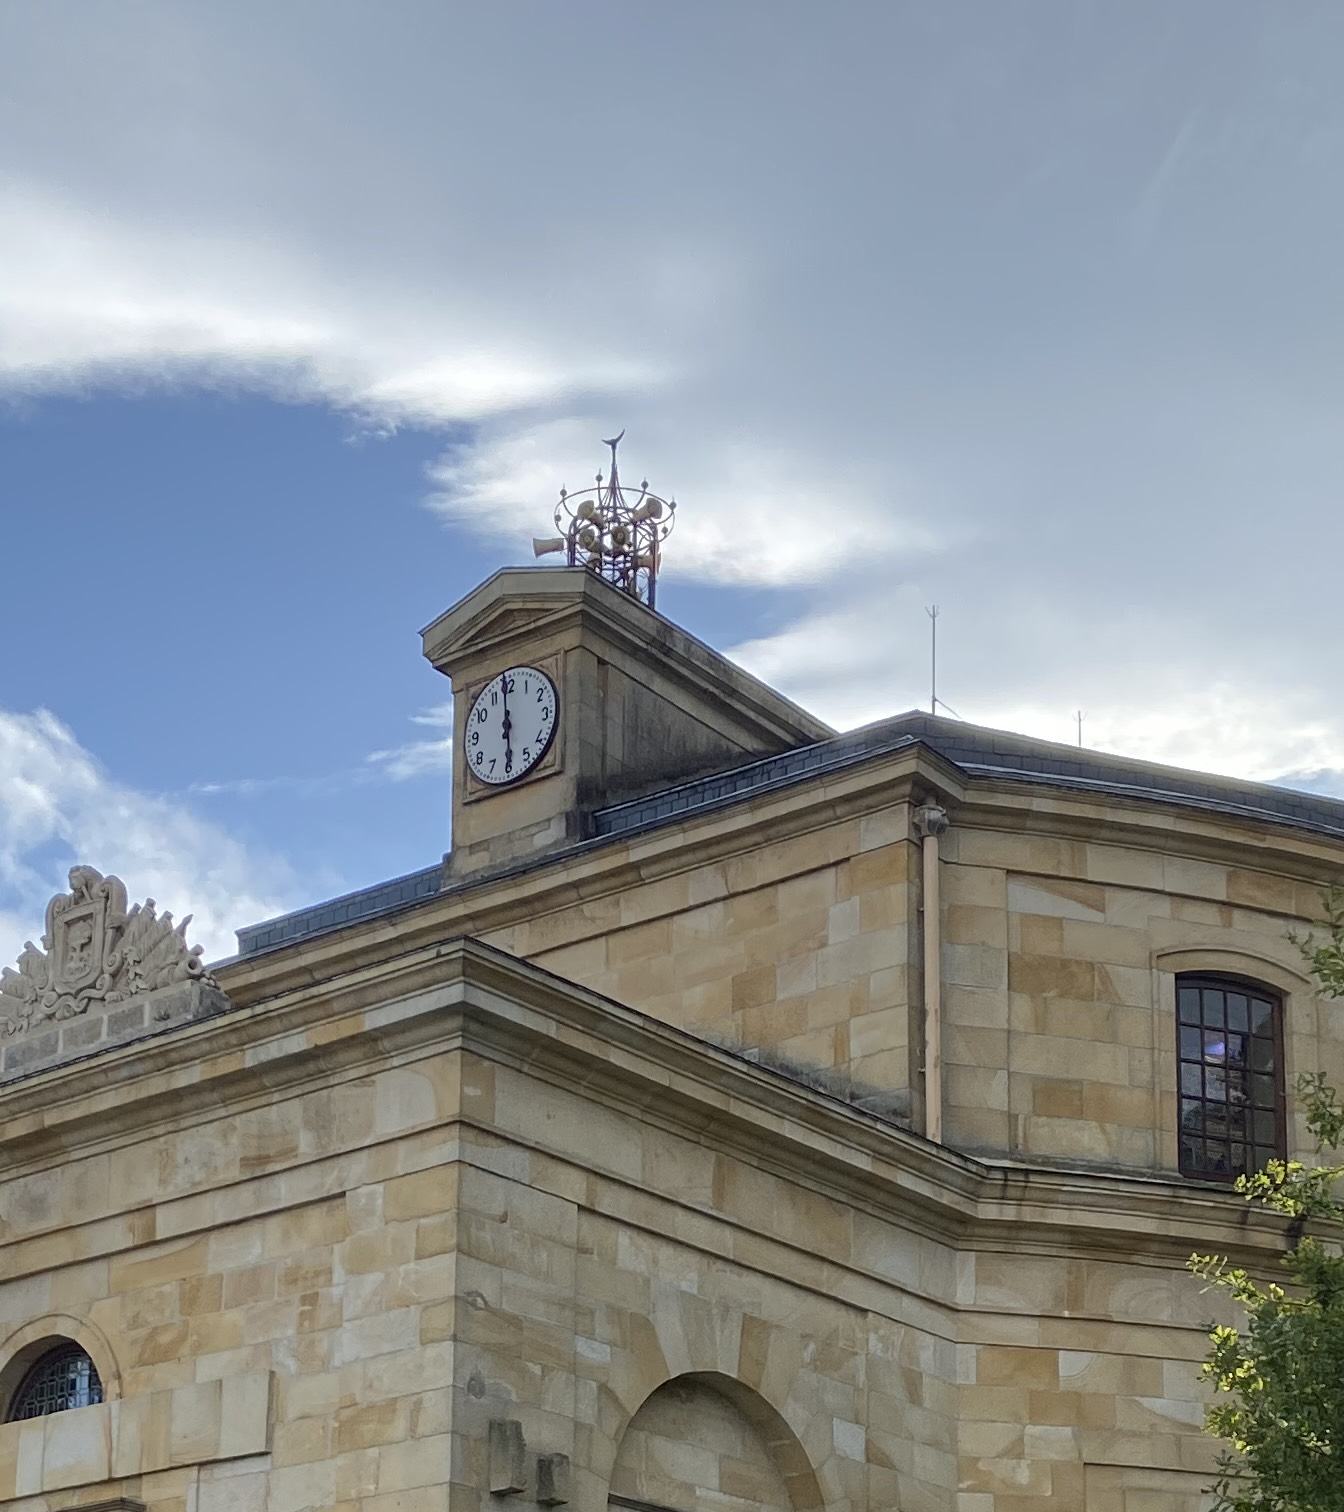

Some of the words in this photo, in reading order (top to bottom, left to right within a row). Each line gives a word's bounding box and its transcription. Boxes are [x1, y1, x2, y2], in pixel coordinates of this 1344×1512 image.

[491, 691, 498, 706] 11
[536, 687, 544, 703] 2
[475, 708, 488, 724] 10
[541, 706, 549, 721] 3
[471, 732, 479, 746] 9
[535, 729, 544, 745] 4
[476, 751, 484, 765] 8
[522, 747, 531, 762] 5
[489, 758, 497, 774] 7
[505, 759, 513, 774] 6
